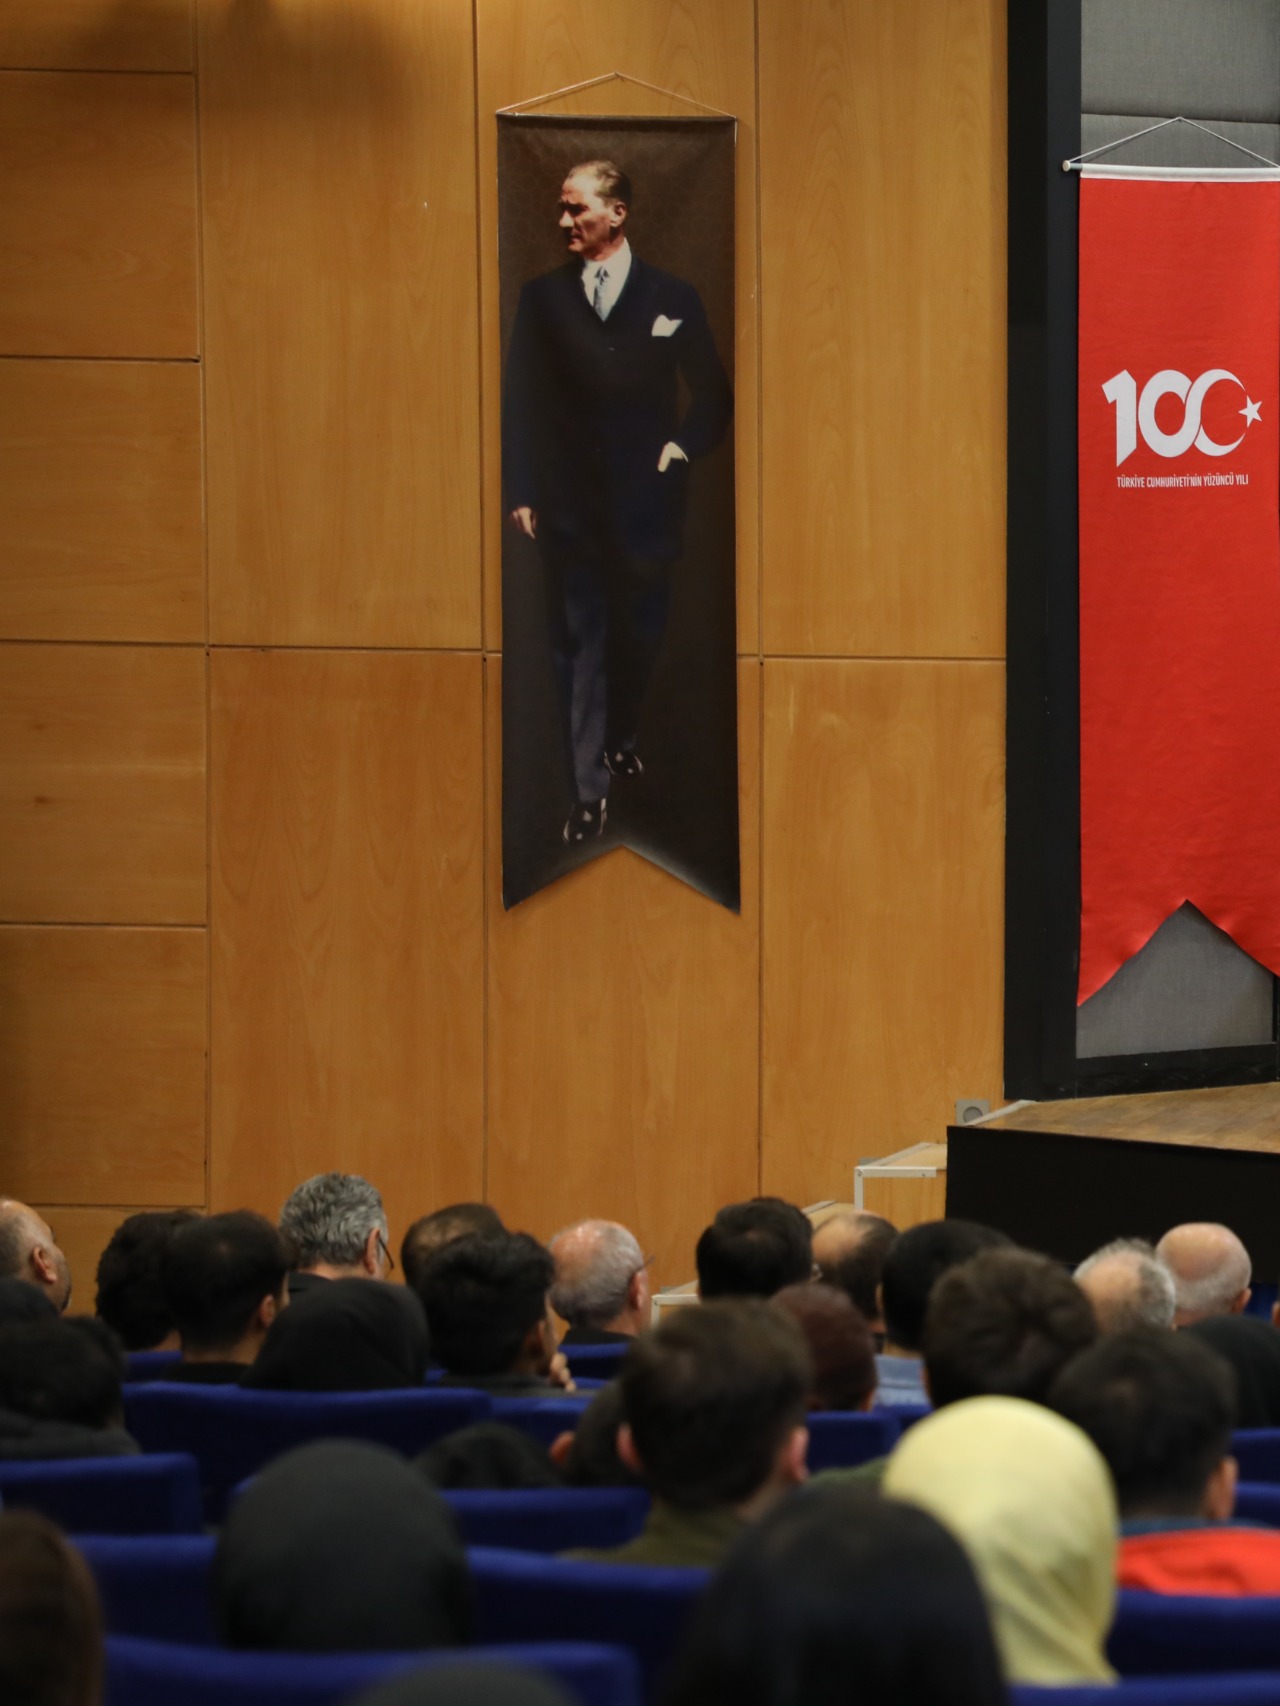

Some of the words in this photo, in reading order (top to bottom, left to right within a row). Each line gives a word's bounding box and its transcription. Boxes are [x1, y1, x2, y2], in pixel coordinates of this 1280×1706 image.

[1102, 369, 1246, 467] 100
[1117, 474, 1145, 488] TÜRKİYE
[1146, 473, 1202, 488] CUMHURİYETİ'NİN
[1203, 472, 1234, 487] YÜZÜNCÜ
[1235, 474, 1249, 486] YILI
